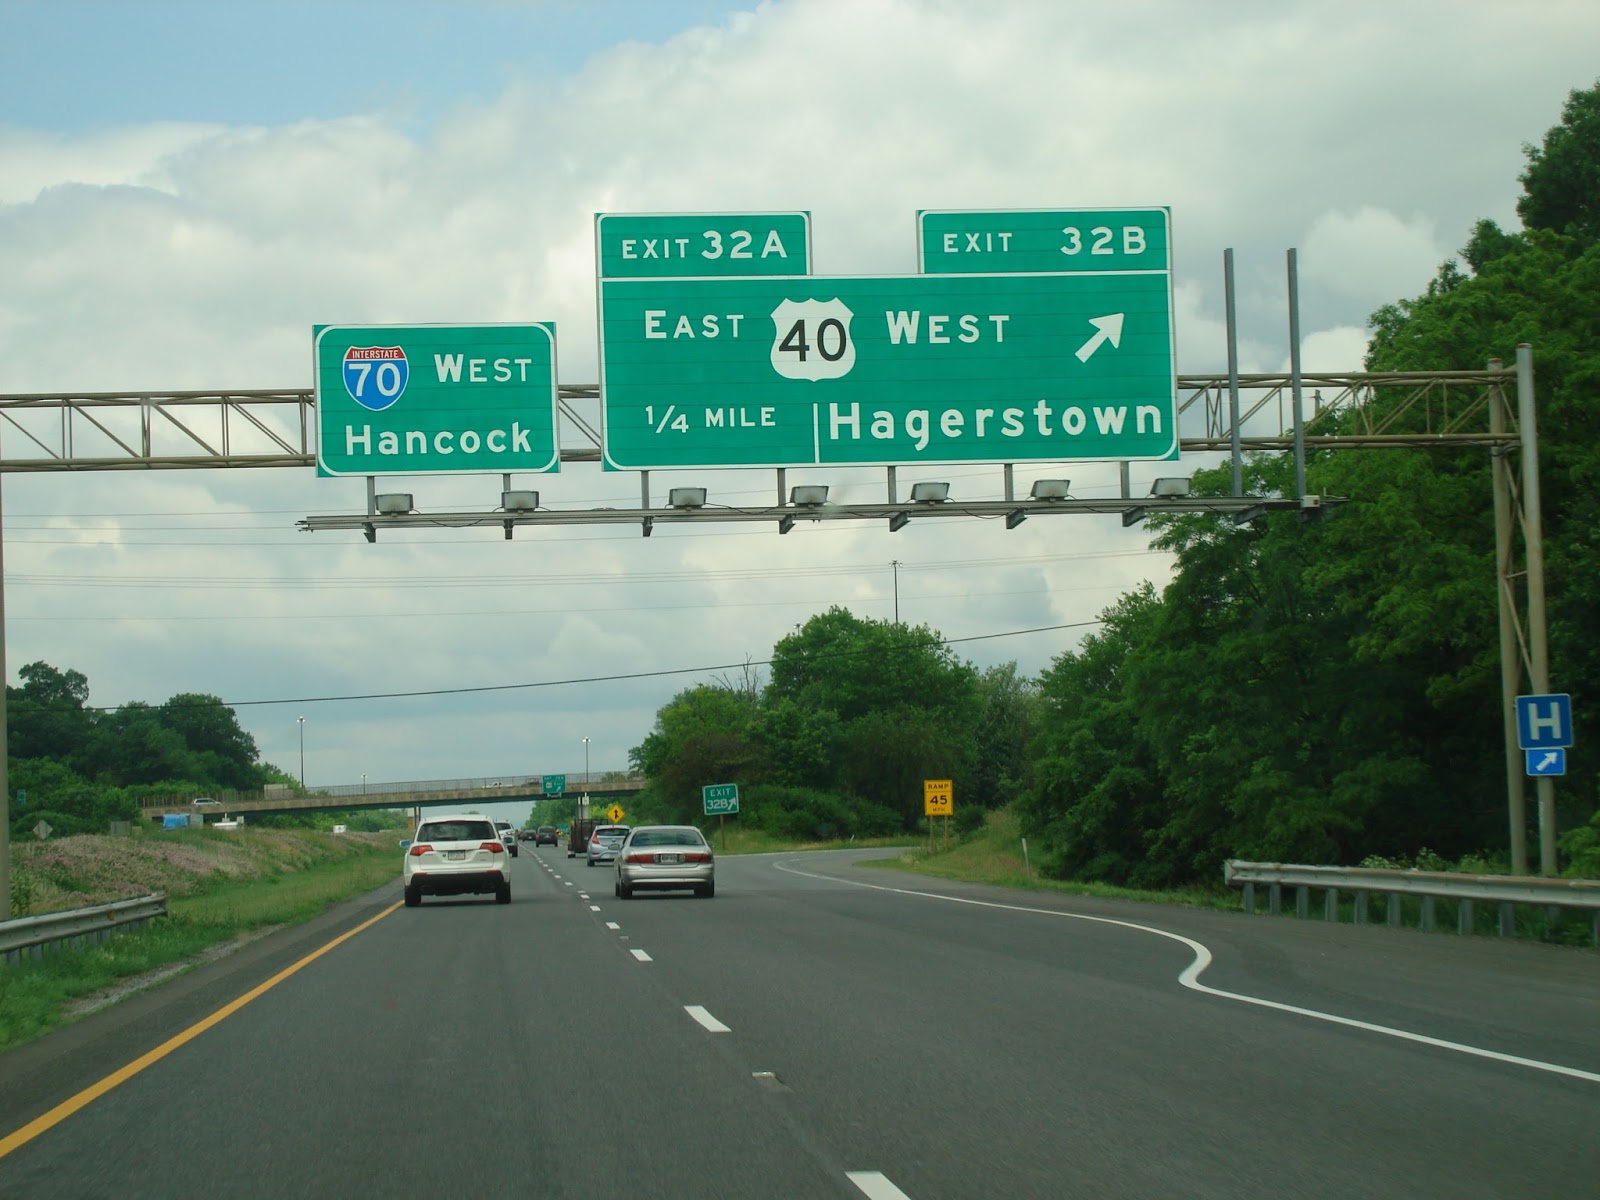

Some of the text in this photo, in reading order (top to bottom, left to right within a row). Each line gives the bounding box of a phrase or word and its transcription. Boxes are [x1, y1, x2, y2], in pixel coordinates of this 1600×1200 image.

[622, 230, 787, 259] EXIT 32A
[943, 226, 1147, 256] EXIT 32B
[645, 310, 744, 339] EAST
[885, 310, 1010, 345] WEST
[352, 349, 399, 359] INTERSTATE
[778, 318, 847, 362] 40
[349, 362, 400, 397] 70
[434, 353, 532, 383] WEST
[705, 407, 776, 428] MILE
[828, 398, 1163, 452] Hagerstown
[345, 421, 532, 456] Hancock
[1528, 701, 1562, 740] H
[706, 798, 729, 810] 32B
[710, 788, 731, 797] EXIT
[929, 795, 948, 805] 45
